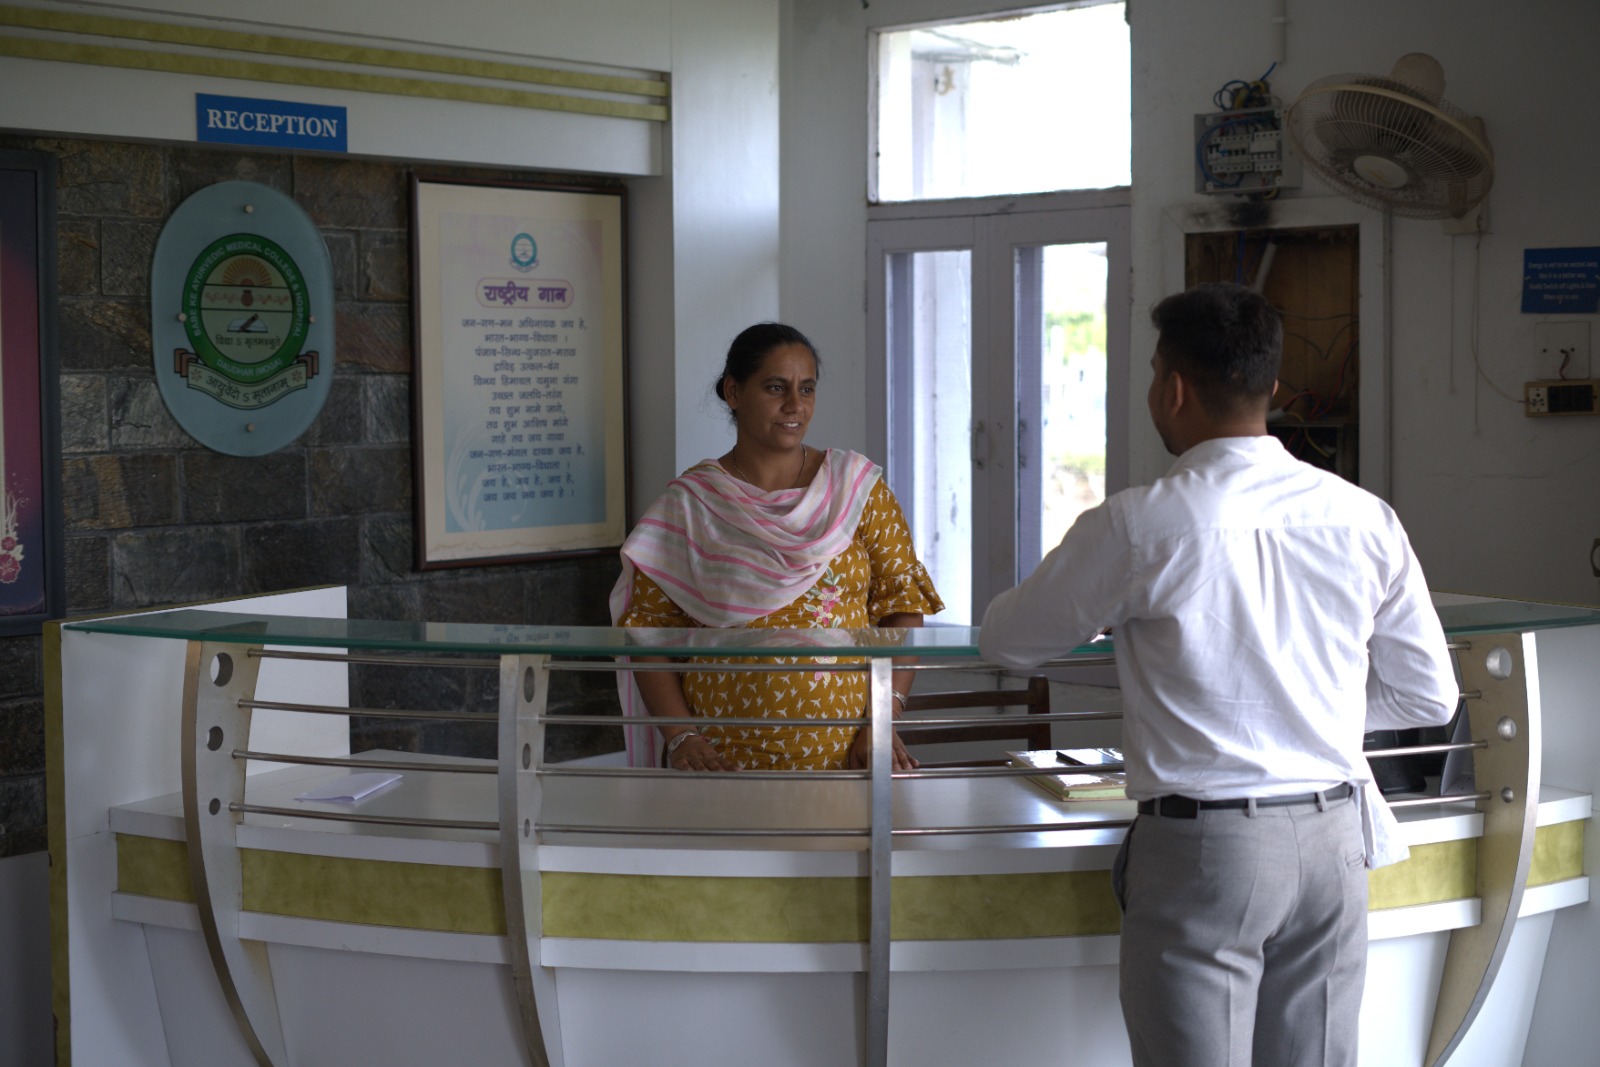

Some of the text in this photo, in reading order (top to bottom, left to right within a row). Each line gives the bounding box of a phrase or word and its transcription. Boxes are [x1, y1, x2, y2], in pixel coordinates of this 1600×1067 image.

[206, 108, 338, 138] RECEPTION
[226, 241, 263, 253] MEDICAL
[193, 248, 226, 290] AYURVEDIC
[264, 247, 297, 282] COLLEGE
[484, 280, 567, 304] राष्ट्रीय गान
[189, 292, 198, 306] KE
[292, 292, 304, 337] HOSPITAL
[561, 320, 574, 328] जय
[506, 406, 520, 417] शुभ
[504, 421, 517, 431] शुभ
[528, 434, 541, 442] जय
[559, 447, 571, 455] जय
